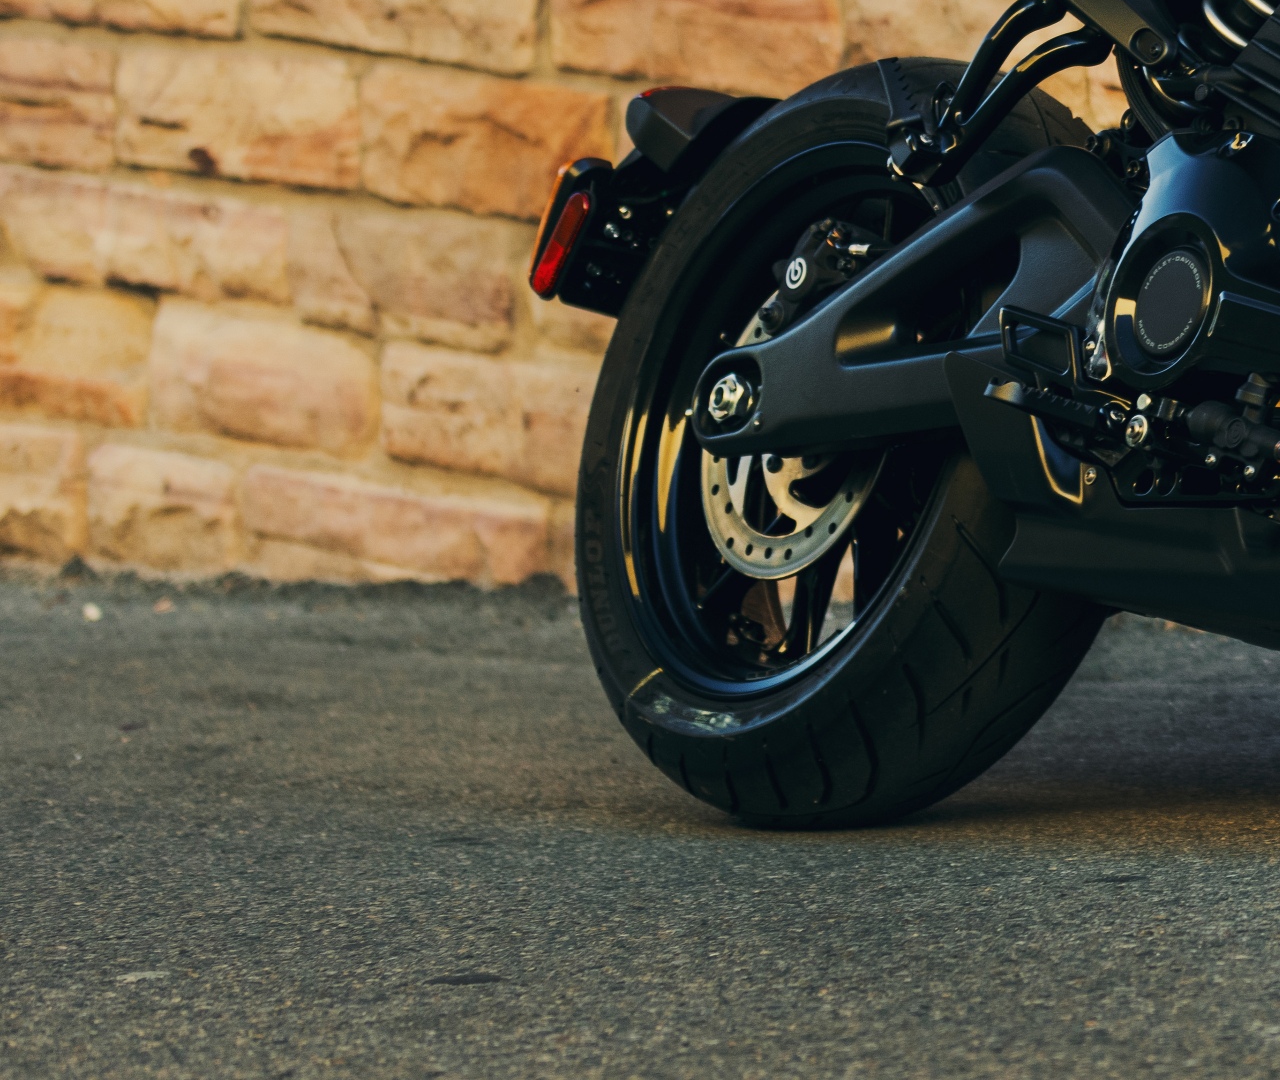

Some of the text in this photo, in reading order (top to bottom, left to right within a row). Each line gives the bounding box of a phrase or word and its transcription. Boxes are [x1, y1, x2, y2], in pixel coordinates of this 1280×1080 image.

[1144, 255, 1201, 289] HARLEY-DAVIDSON
[1138, 317, 1193, 350] MOTOR COMPANY
